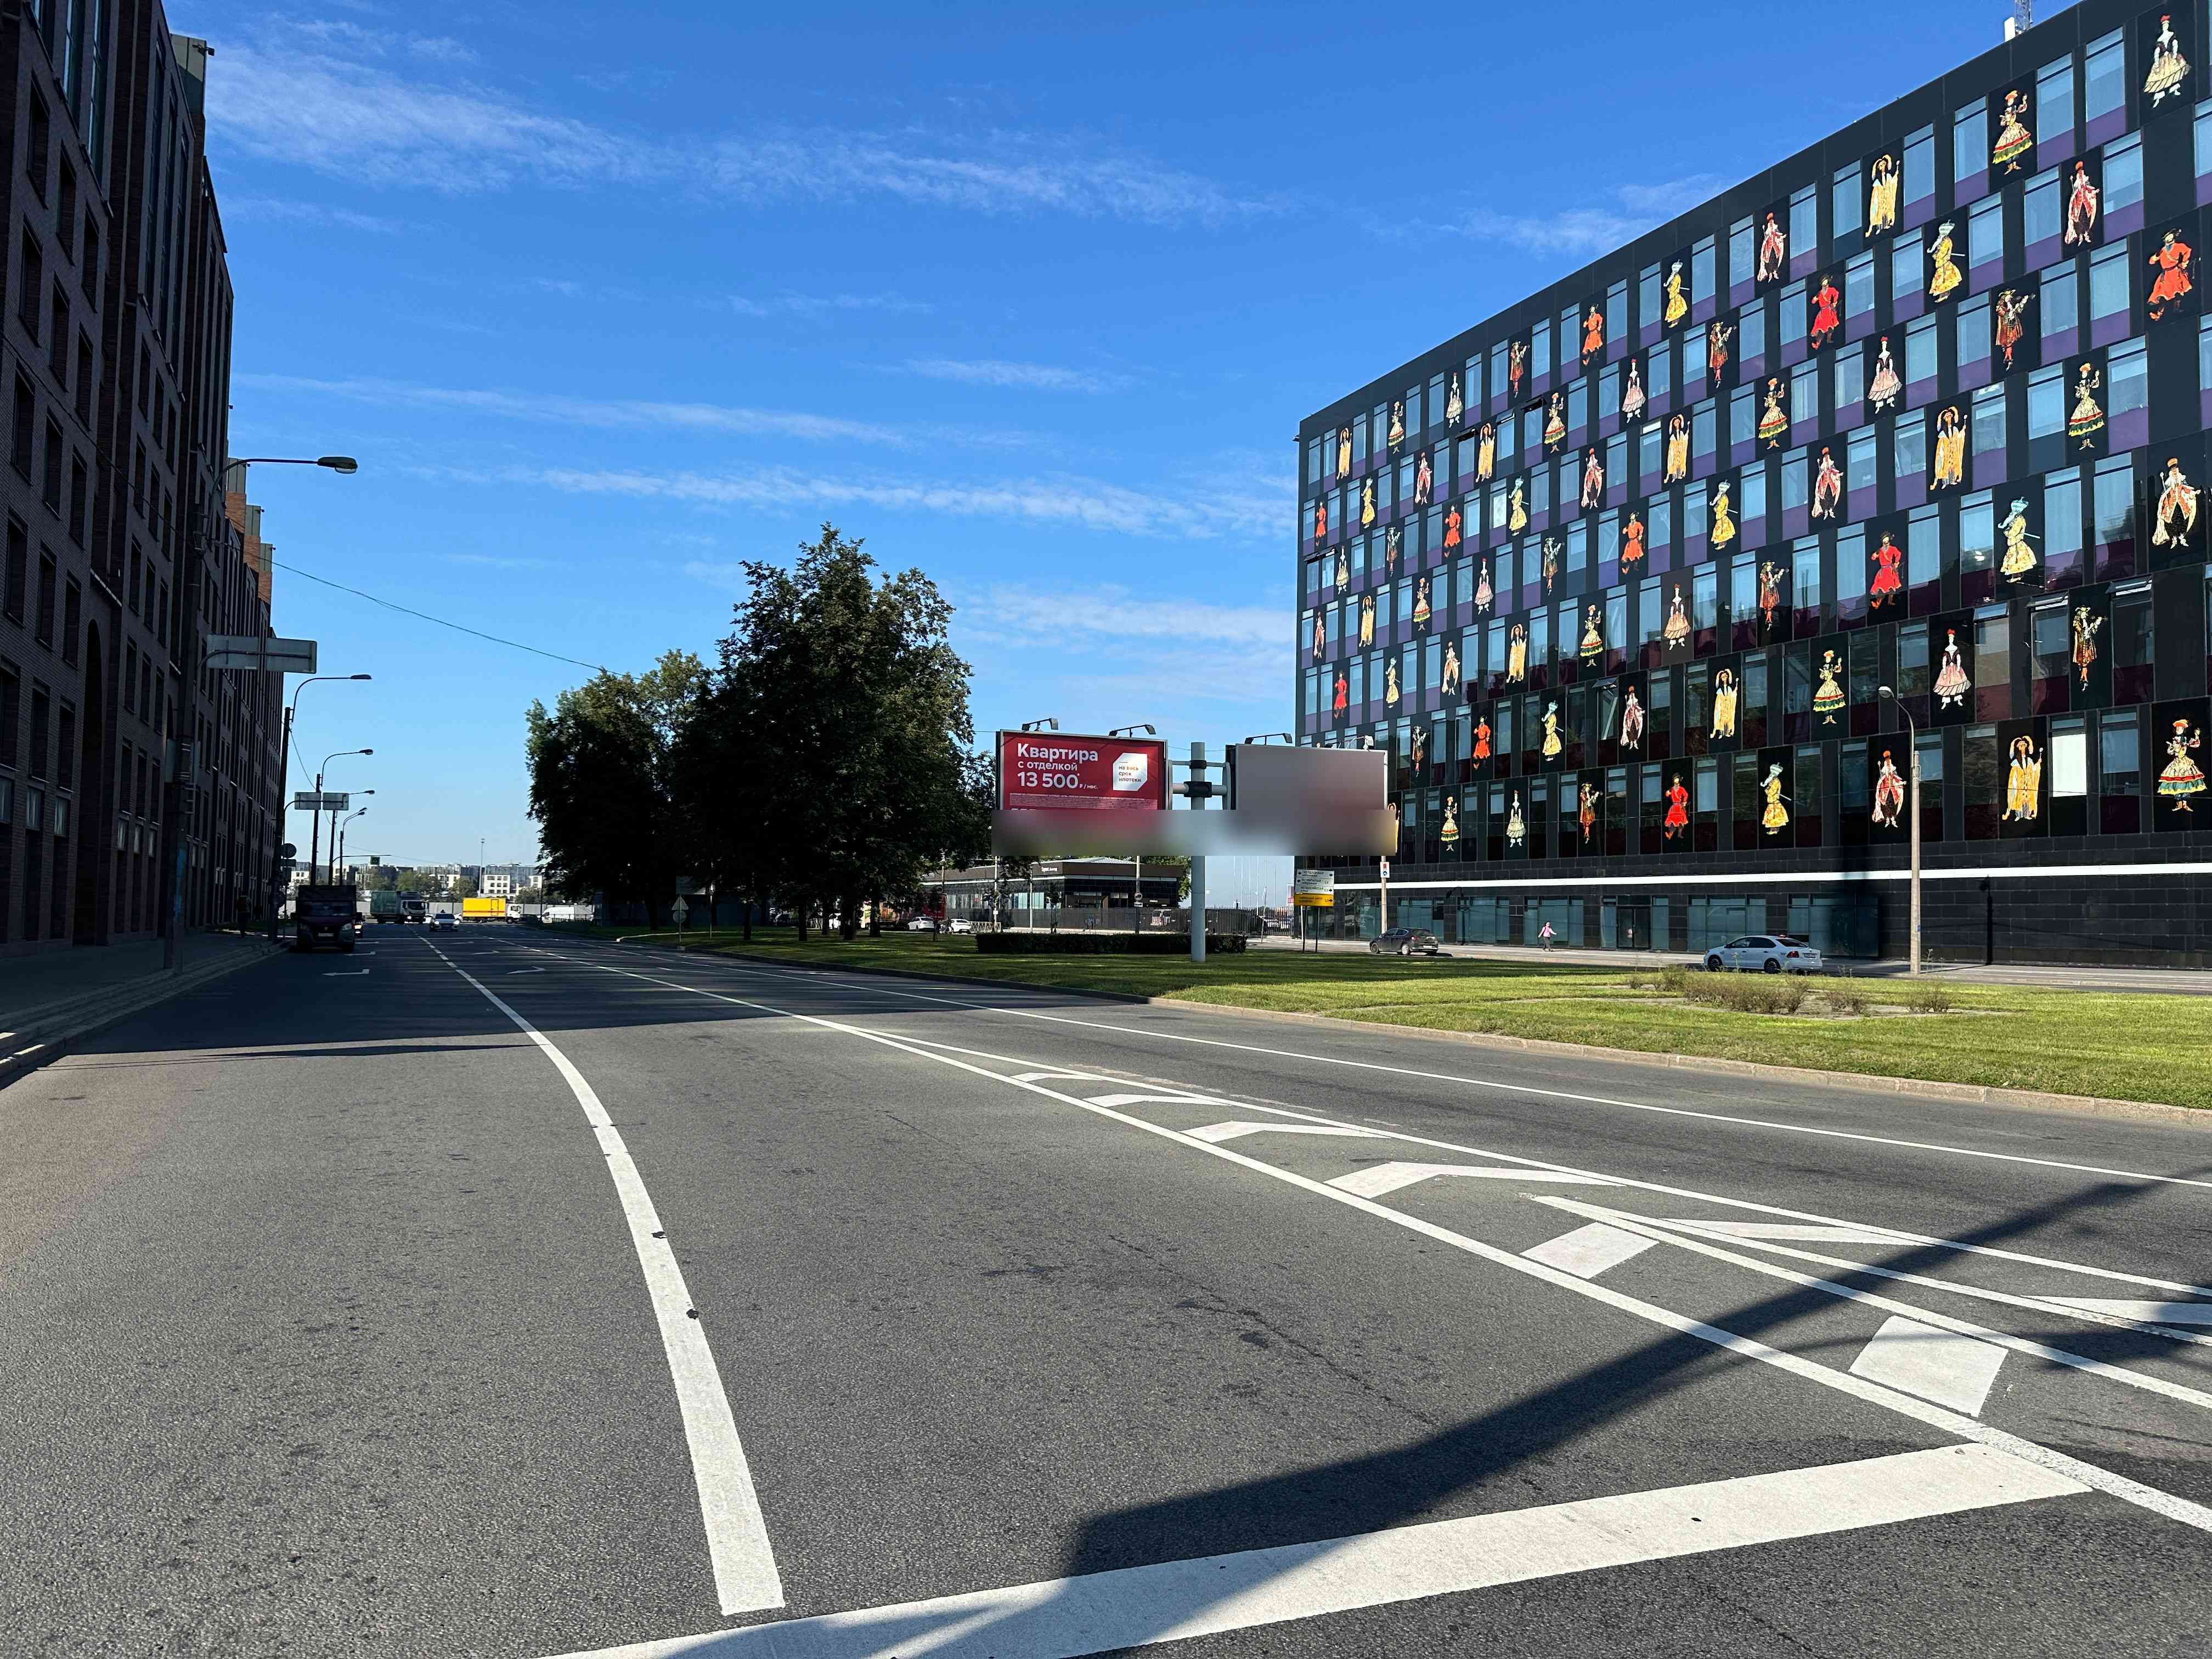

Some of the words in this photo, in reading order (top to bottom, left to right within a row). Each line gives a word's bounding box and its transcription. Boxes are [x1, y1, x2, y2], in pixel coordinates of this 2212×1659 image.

[1018, 743, 1098, 764] Квартира
[1026, 761, 1077, 771] отделкой
[1017, 771, 1038, 787] 13
